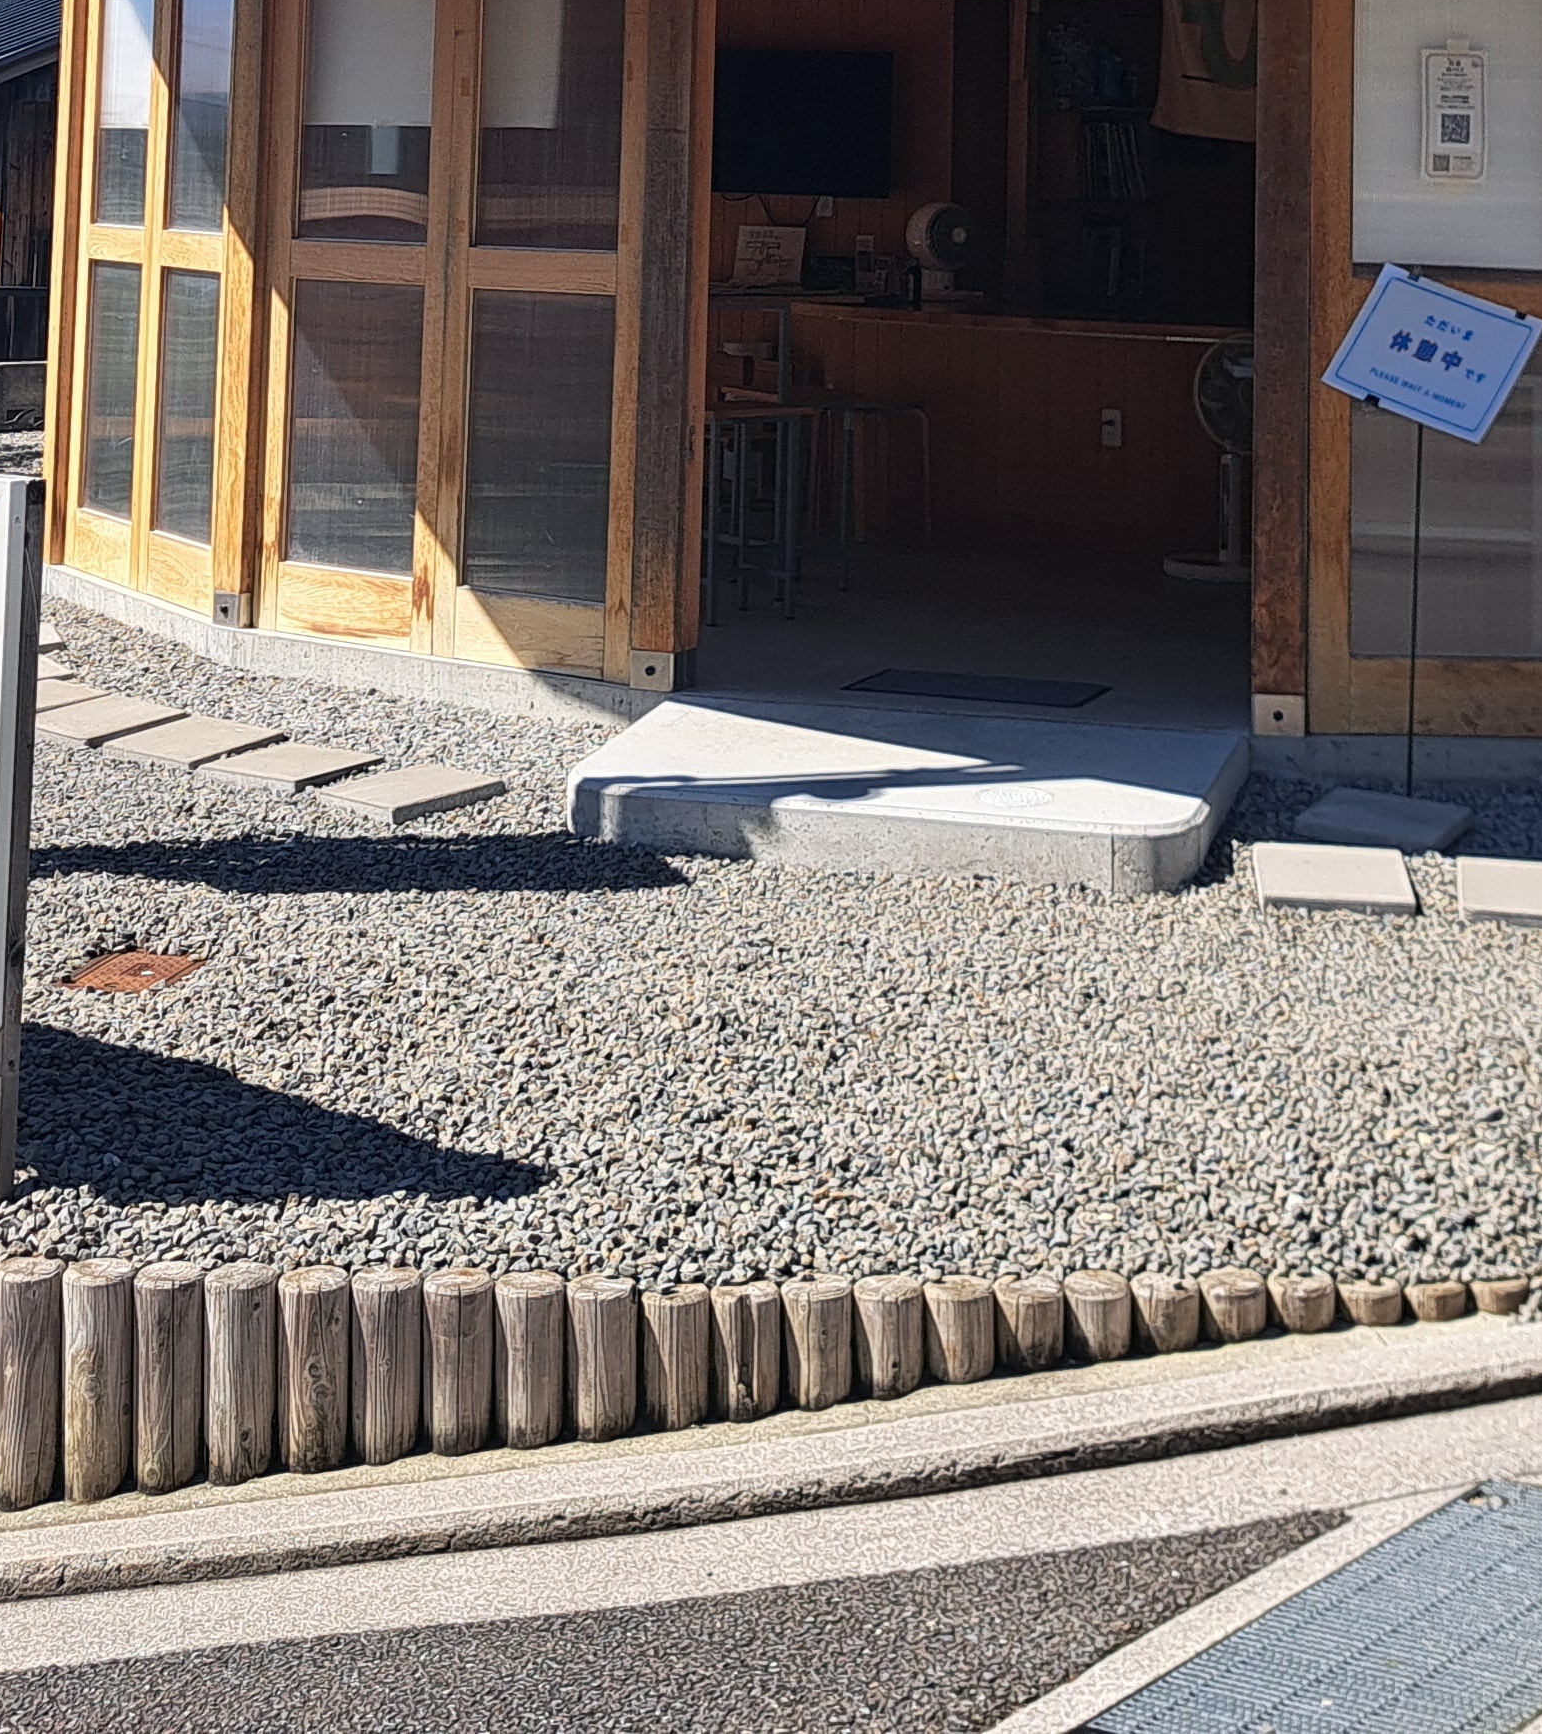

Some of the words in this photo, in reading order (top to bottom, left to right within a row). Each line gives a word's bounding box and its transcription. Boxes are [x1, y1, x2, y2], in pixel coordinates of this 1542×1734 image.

[1424, 314, 1474, 342] ただいま
[1369, 366, 1400, 385] PLEASE
[1400, 379, 1423, 393] WAIT
[1431, 391, 1468, 410] MOMENT
